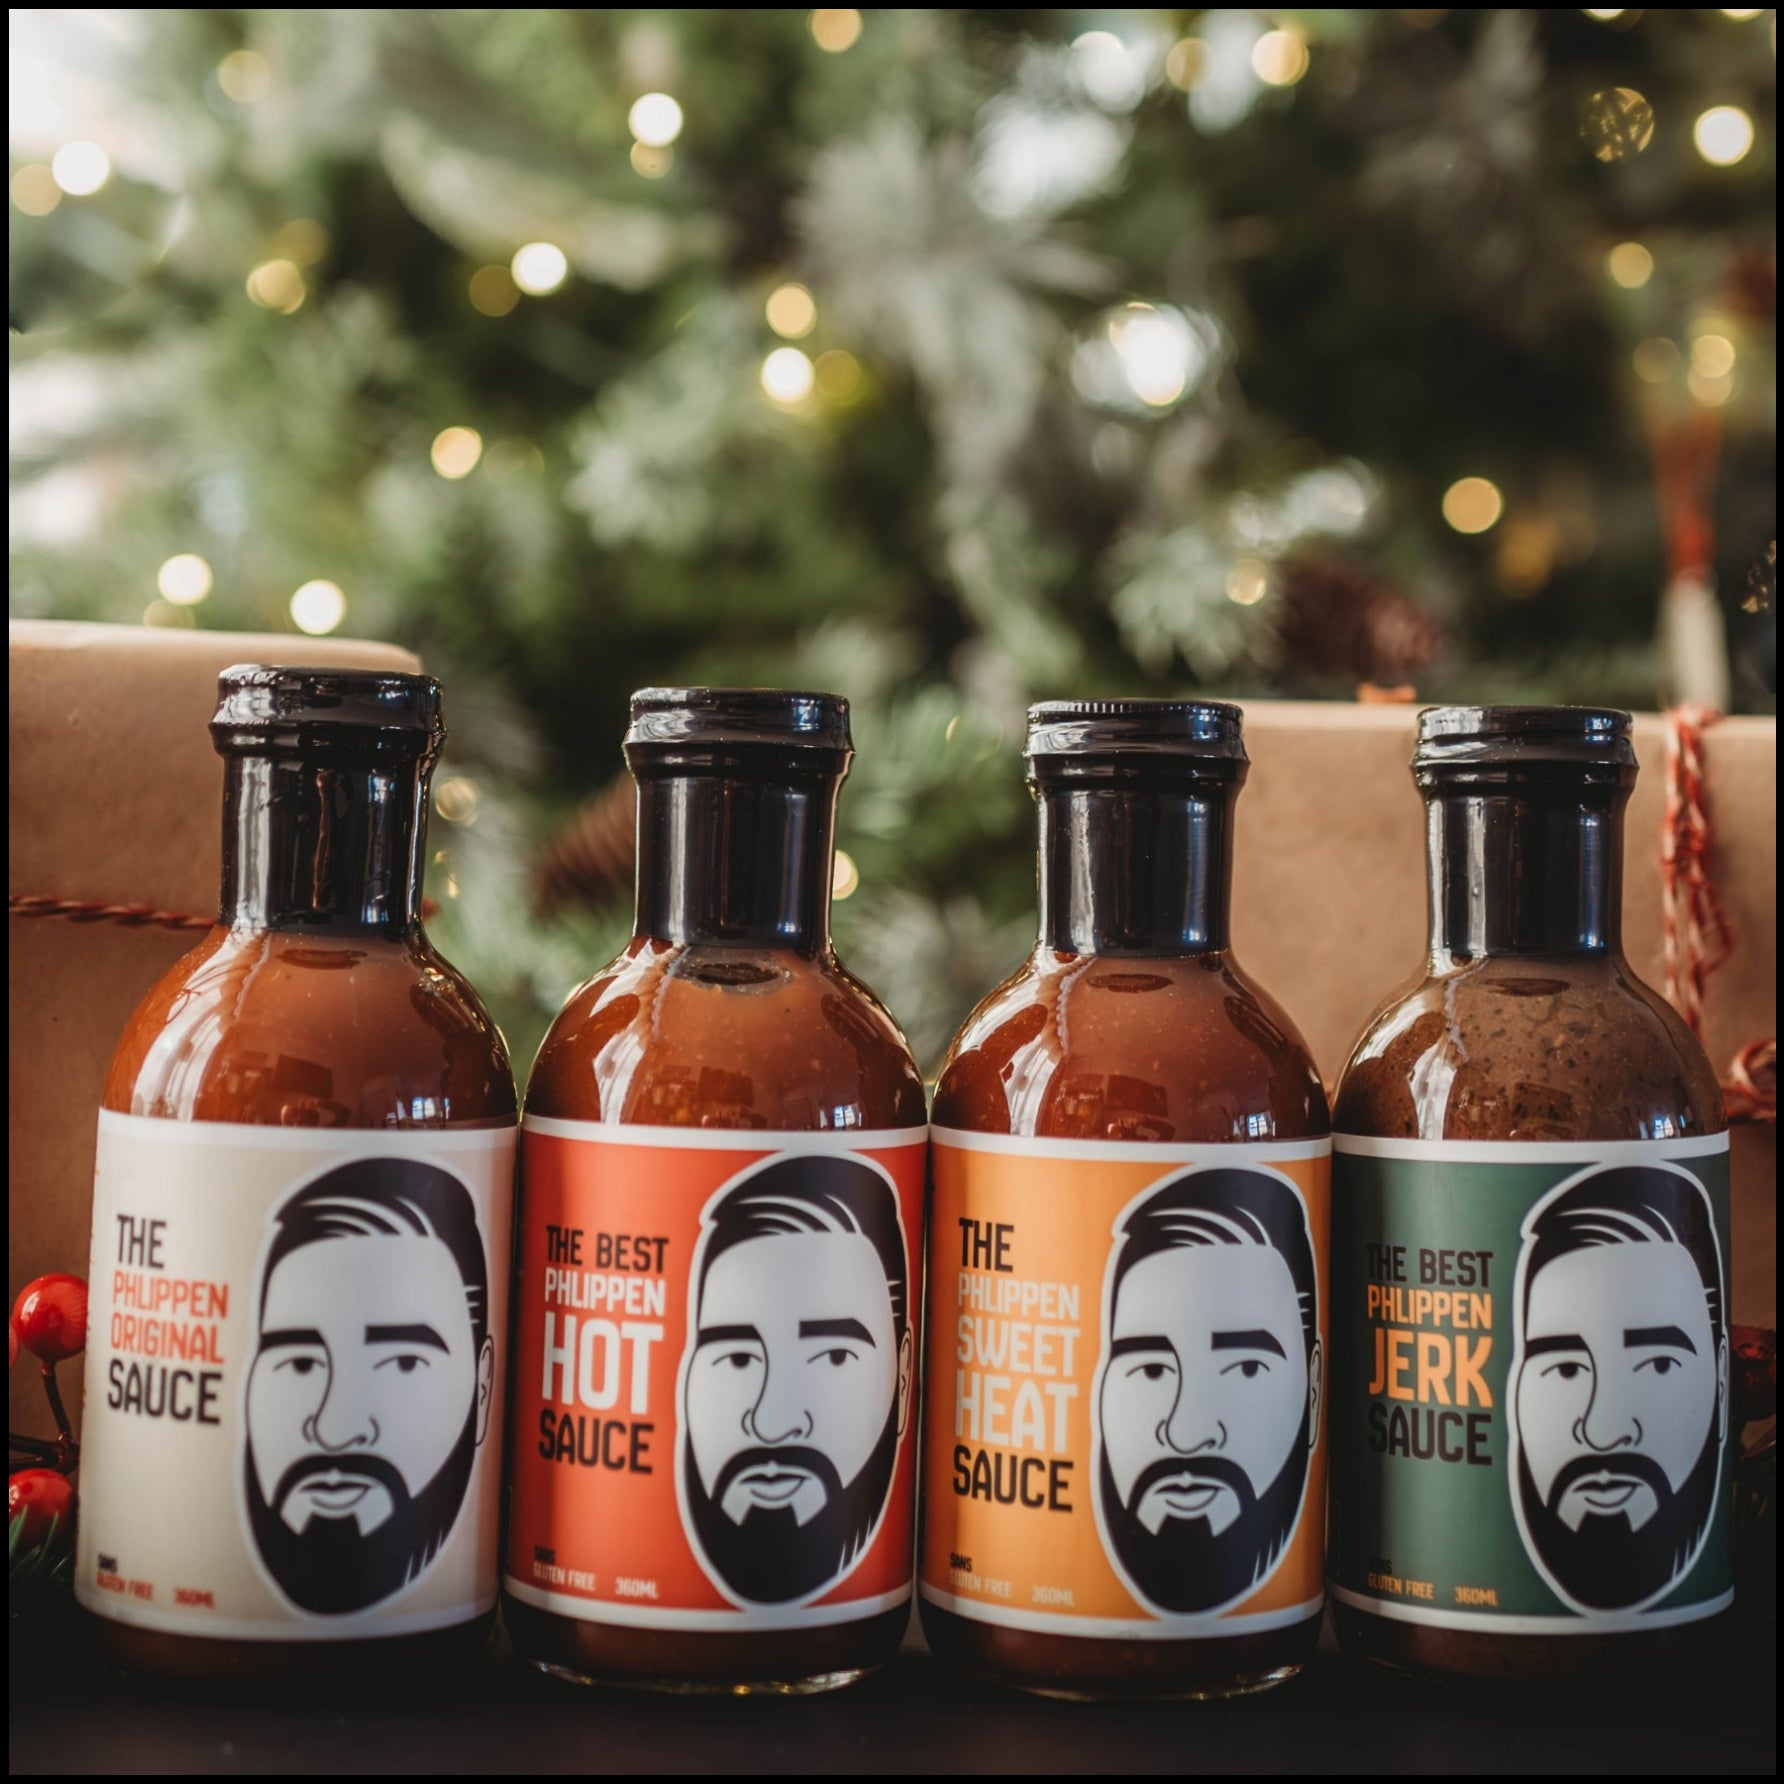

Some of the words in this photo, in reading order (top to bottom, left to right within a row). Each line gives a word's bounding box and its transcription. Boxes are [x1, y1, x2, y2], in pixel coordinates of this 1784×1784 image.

[117, 1214, 167, 1270] THE
[545, 1224, 583, 1266] THE
[596, 1232, 669, 1274] BEST
[959, 1217, 1015, 1273] THE
[1366, 1243, 1407, 1283] THE
[1420, 1248, 1493, 1287] BEST
[113, 1270, 229, 1320] PHLIPPEN
[545, 1267, 666, 1317] PHLIPPEN
[958, 1272, 1080, 1321] PHLIPPEN
[1368, 1284, 1493, 1330] PHLIPPEN
[110, 1311, 225, 1365] ORIGINAL
[542, 1310, 664, 1415] HOT
[957, 1314, 1081, 1378] SWEET
[108, 1358, 223, 1426] SAUCE
[1369, 1327, 1493, 1408] JERK
[955, 1369, 1079, 1453] HEAT
[1368, 1402, 1493, 1466] SAUCE
[538, 1407, 654, 1475] SAUCE
[953, 1443, 1074, 1513] SAUCE
[533, 1561, 565, 1585] GLUTEN
[568, 1569, 596, 1592] FREE
[615, 1576, 658, 1599] 360ML
[984, 1577, 1012, 1598] FREE
[1032, 1585, 1075, 1607] 360ML
[1368, 1573, 1402, 1595] GLUTEN
[1405, 1580, 1434, 1600] FREE
[1455, 1586, 1498, 1607] 360ML
